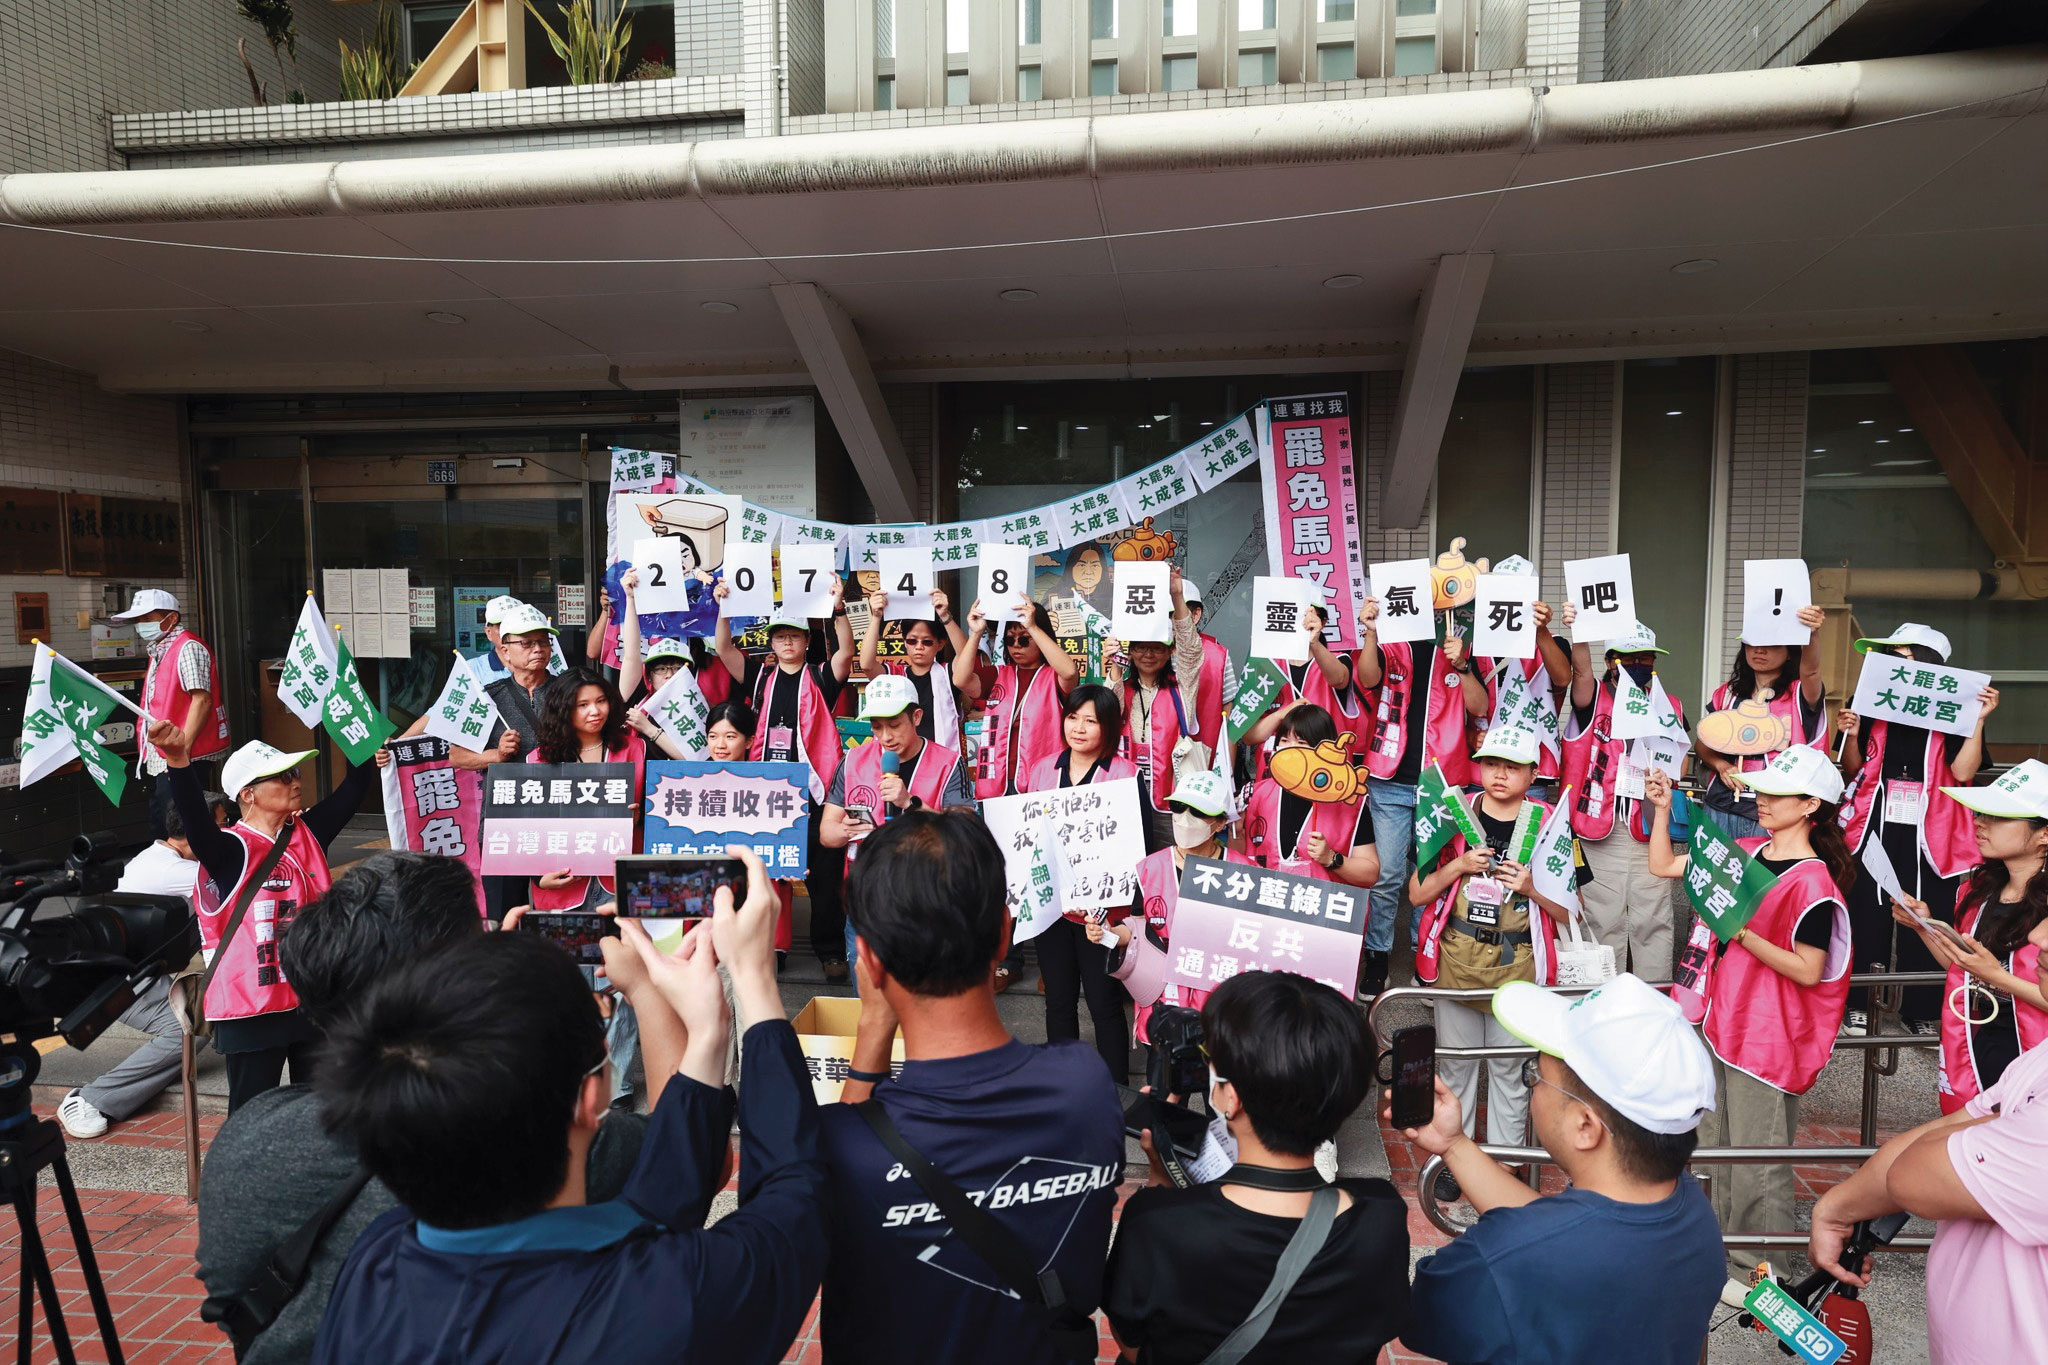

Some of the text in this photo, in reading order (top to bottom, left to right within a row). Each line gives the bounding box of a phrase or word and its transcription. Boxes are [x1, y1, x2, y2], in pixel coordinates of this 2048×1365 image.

[1273, 399, 1343, 418] 連署找我
[1200, 428, 1239, 458] 大罷免
[1338, 427, 1350, 450] 中寮
[617, 450, 651, 466] 大罷免
[1205, 439, 1253, 479] 大成宮
[434, 470, 455, 482] 669
[613, 462, 656, 483] 大成宮
[1136, 463, 1176, 491] 大罷免
[1341, 465, 1353, 487] 國姓
[1069, 492, 1110, 516] 大罷免
[1138, 476, 1187, 512] 大成宮
[1001, 514, 1042, 534] 大罷免
[1070, 507, 1120, 537] 大成宮
[1344, 502, 1356, 525] 仁愛
[797, 524, 836, 542] 大罷免
[865, 531, 906, 545] 大罷免
[933, 525, 974, 542] 大罷免
[931, 541, 979, 563] 大成宮
[1347, 540, 1360, 563] 埔里
[648, 562, 667, 587] 2
[735, 567, 755, 592] 0
[799, 569, 818, 593] 7
[897, 572, 917, 597] 4
[990, 569, 1009, 594] 8
[1351, 577, 1364, 600] 草屯
[1125, 585, 1156, 615] 惡
[1384, 585, 1420, 618] 氣
[1580, 581, 1620, 614] 吧
[1773, 588, 1784, 617] !
[1264, 601, 1298, 633] 靈
[1487, 600, 1523, 632] 死
[294, 624, 330, 686] 大罷免
[1890, 664, 1959, 695] 大罷免
[1874, 687, 1963, 724] 大成宮
[660, 699, 709, 753] 大成宮
[492, 778, 629, 806] 罷免馬文君
[664, 788, 794, 819] 持續收件
[487, 830, 626, 856] 台灣更安心
[1013, 815, 1118, 851] 我會害怕
[1693, 823, 1746, 886] 大罷免
[1192, 863, 1356, 923] 不分藍綠白
[1687, 862, 1739, 920] 成宮
[1227, 917, 1306, 962] 反共
[1752, 1286, 1832, 1359] CTS 華視
